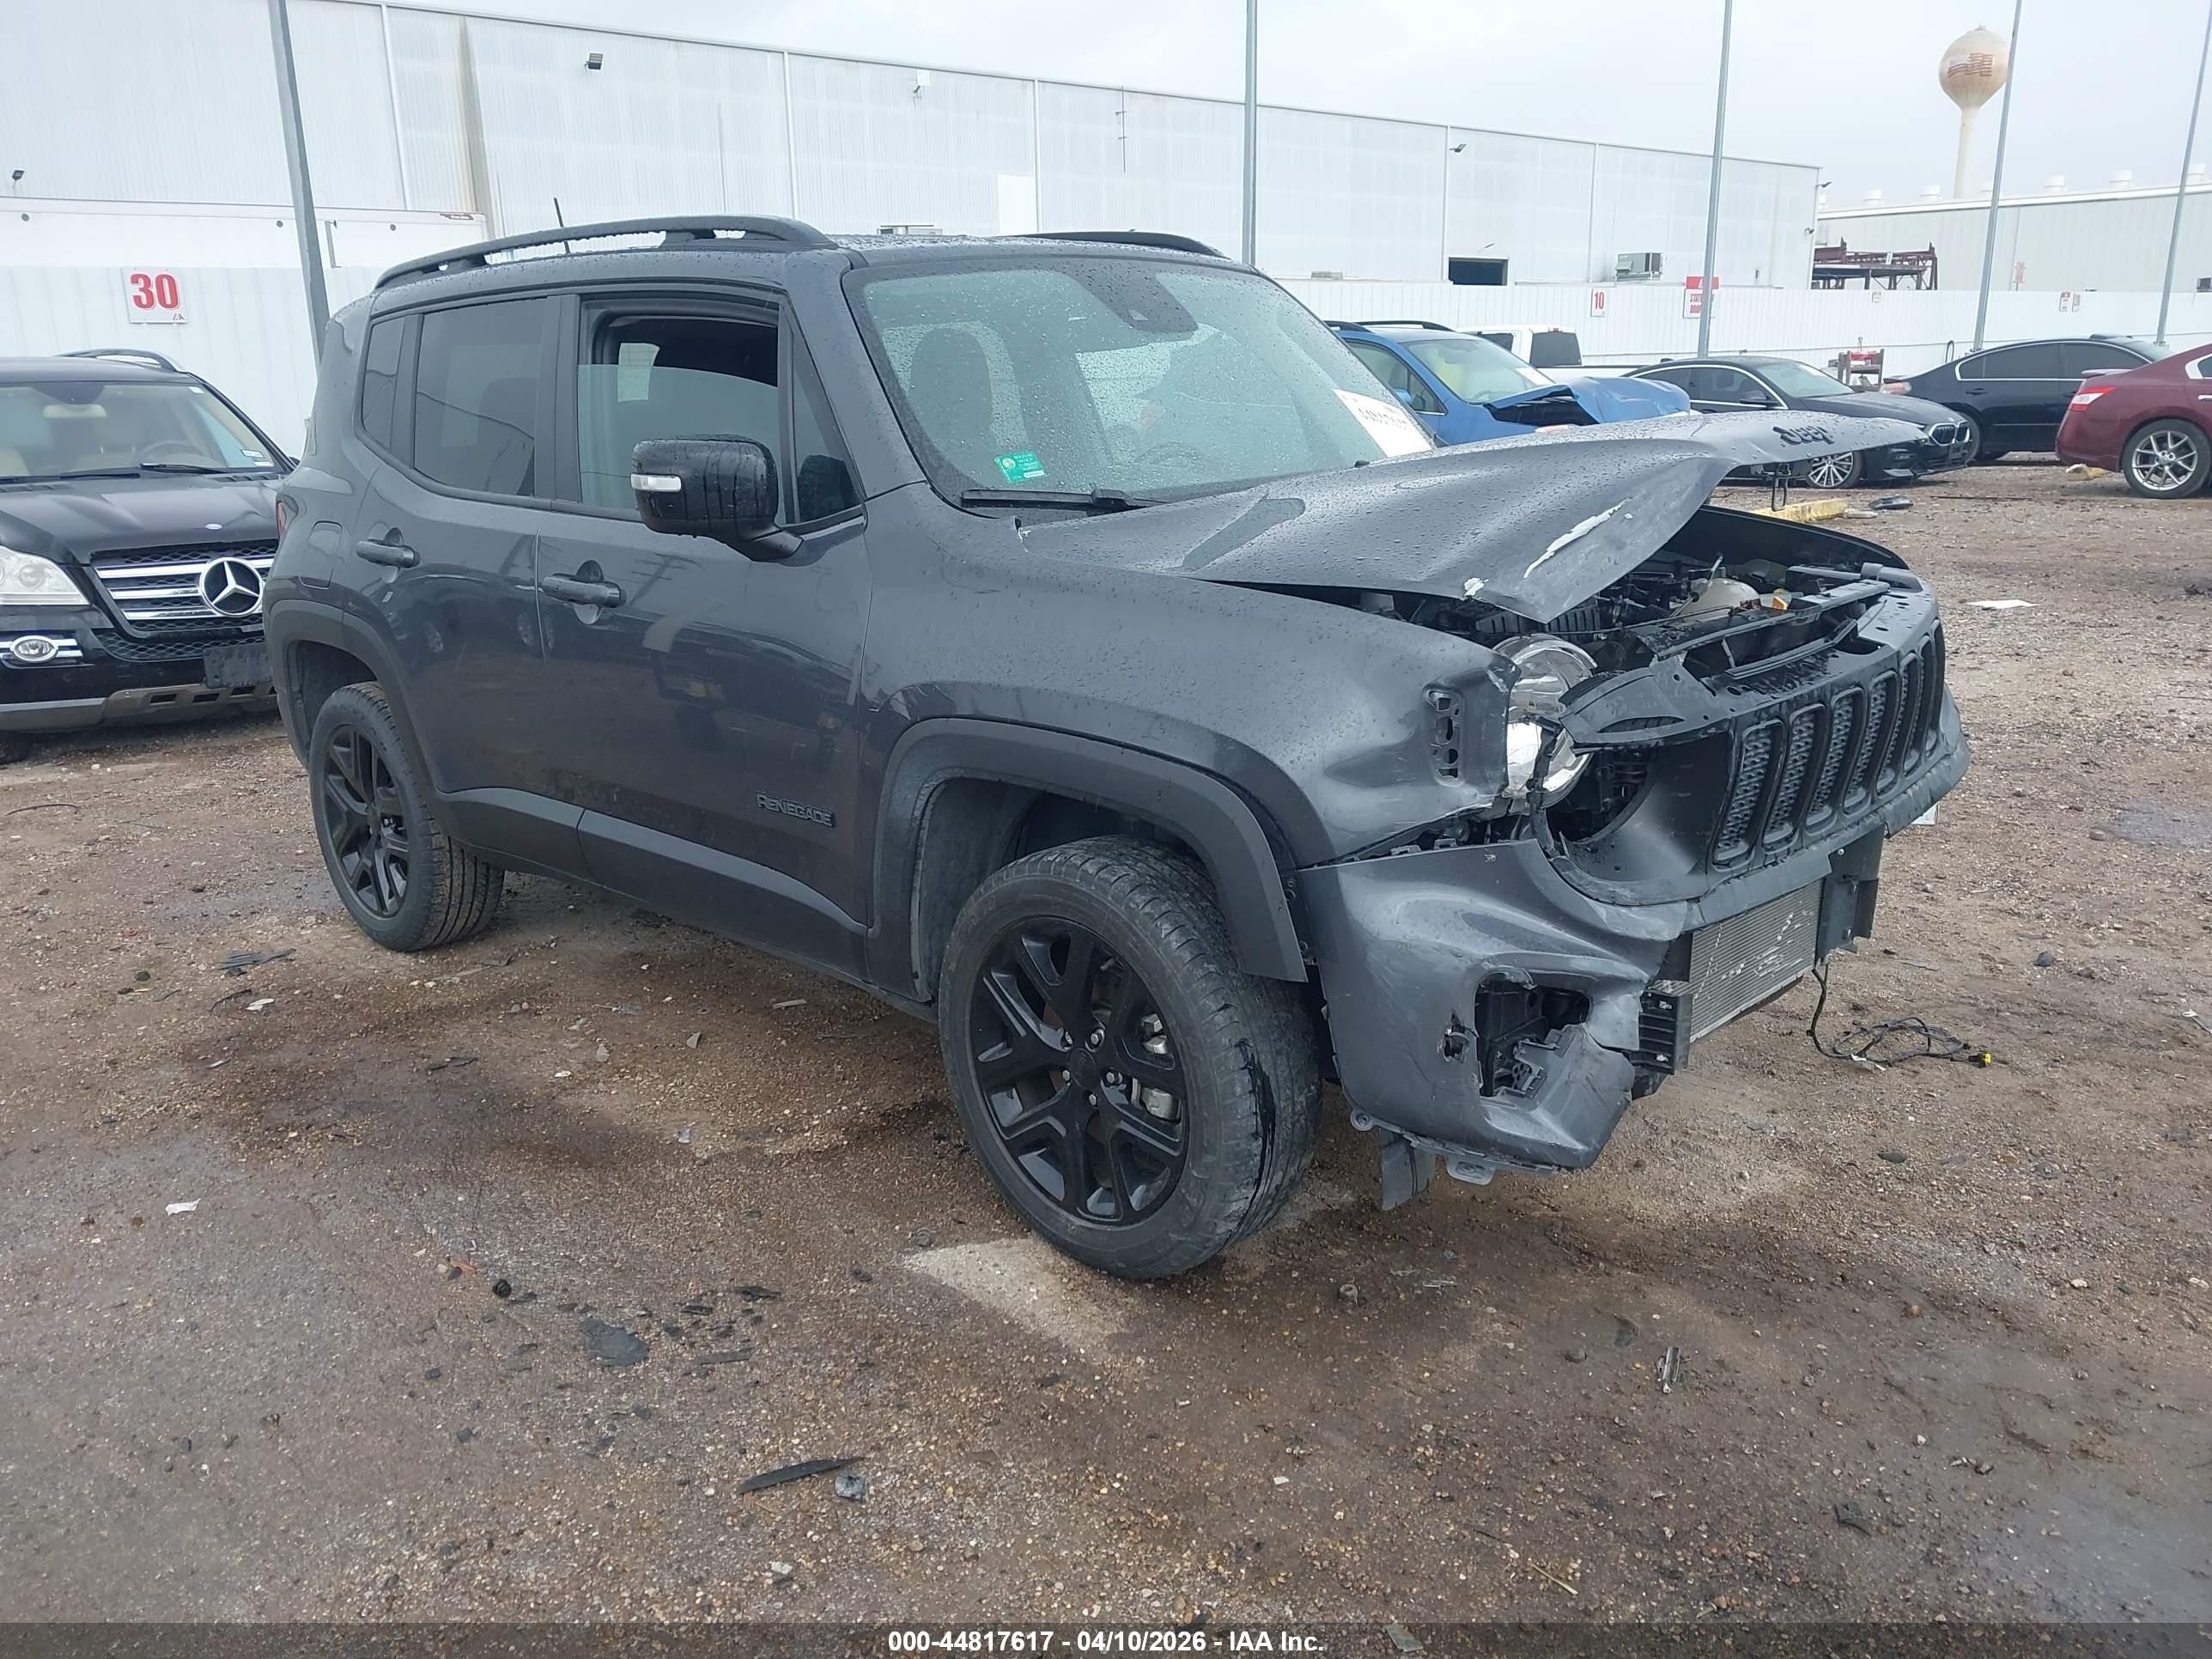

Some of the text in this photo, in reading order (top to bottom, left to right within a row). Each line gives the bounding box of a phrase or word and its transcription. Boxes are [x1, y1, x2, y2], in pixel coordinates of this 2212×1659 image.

[130, 273, 179, 309] 30
[1594, 291, 1605, 310] 10
[1771, 426, 1836, 447] Jeep
[756, 791, 836, 828] RENEGADE
